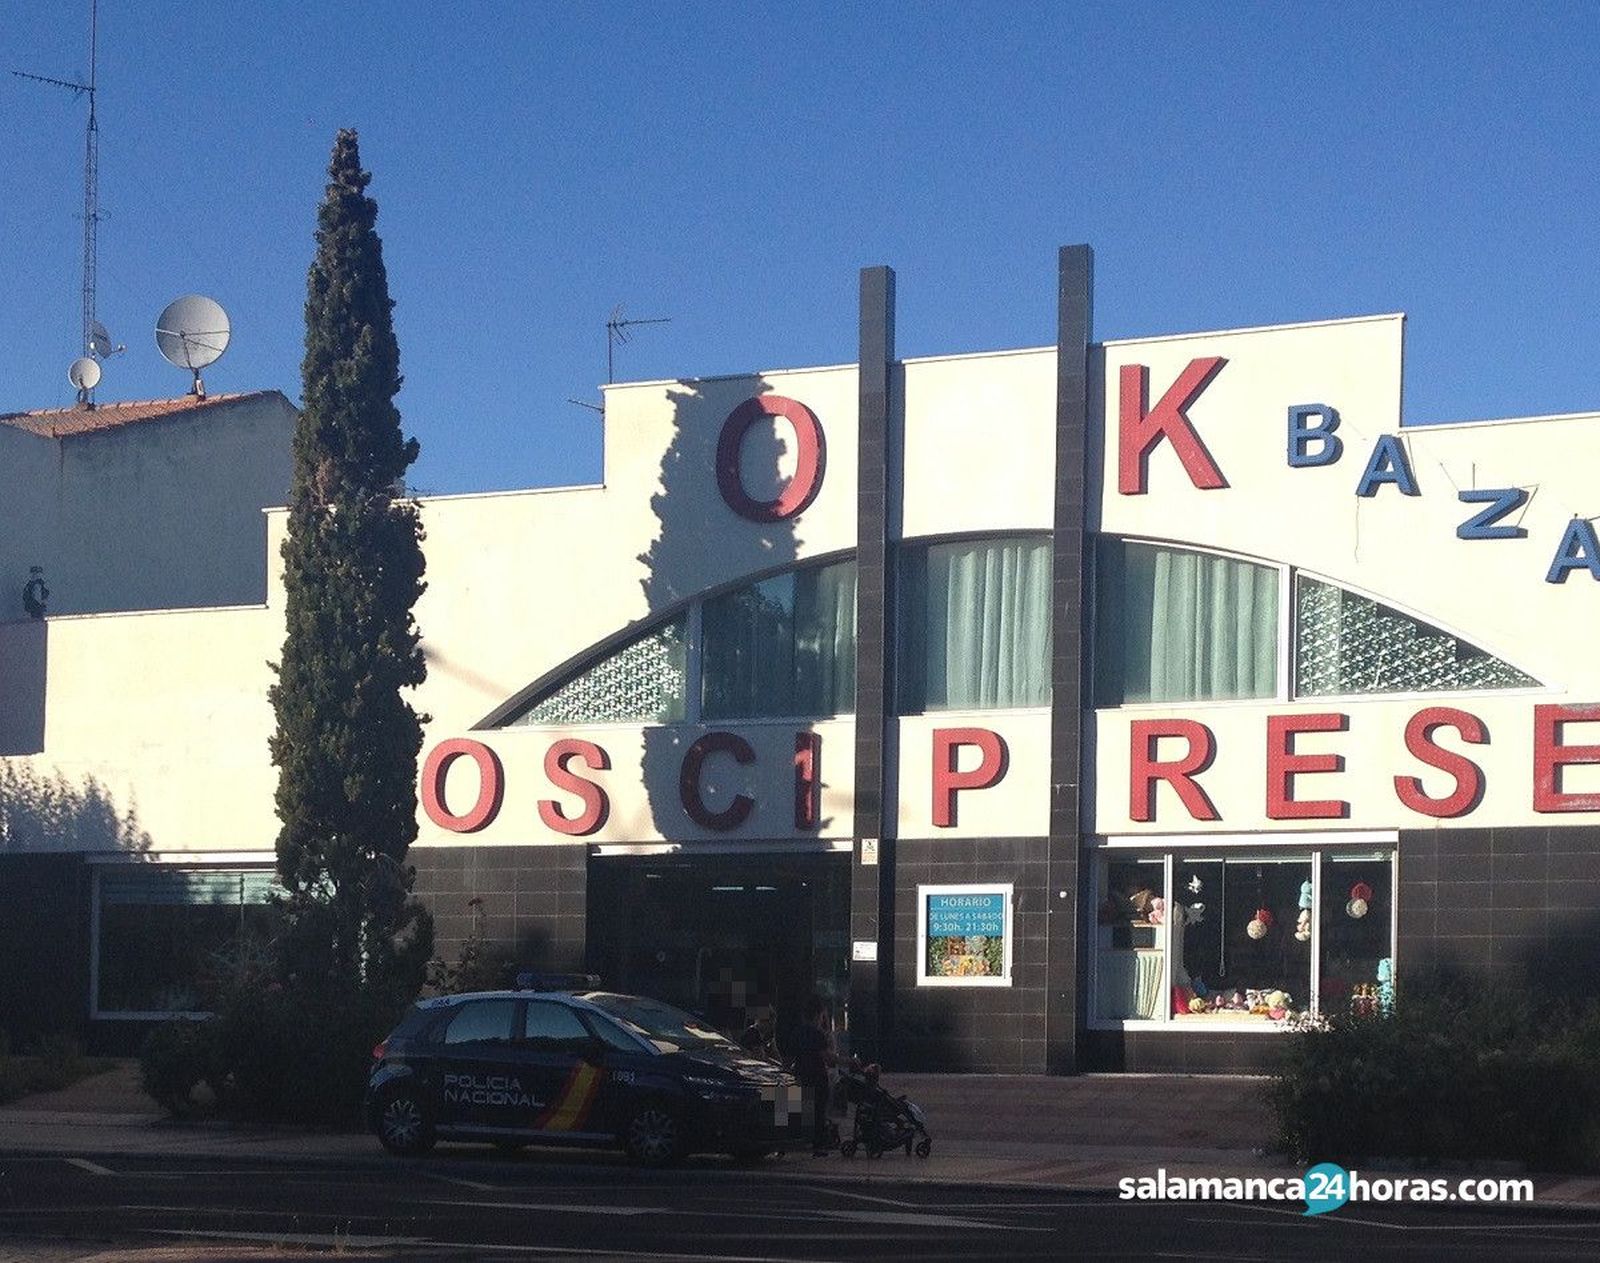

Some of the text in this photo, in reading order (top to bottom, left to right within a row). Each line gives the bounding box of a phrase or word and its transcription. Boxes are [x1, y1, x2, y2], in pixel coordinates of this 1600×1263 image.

[1287, 403, 1600, 583] BAZA
[680, 702, 1600, 832] CIPRESE
[940, 897, 991, 907] HORARIO
[443, 1074, 521, 1090] POLICIA
[444, 1089, 545, 1107] NACIONAL
